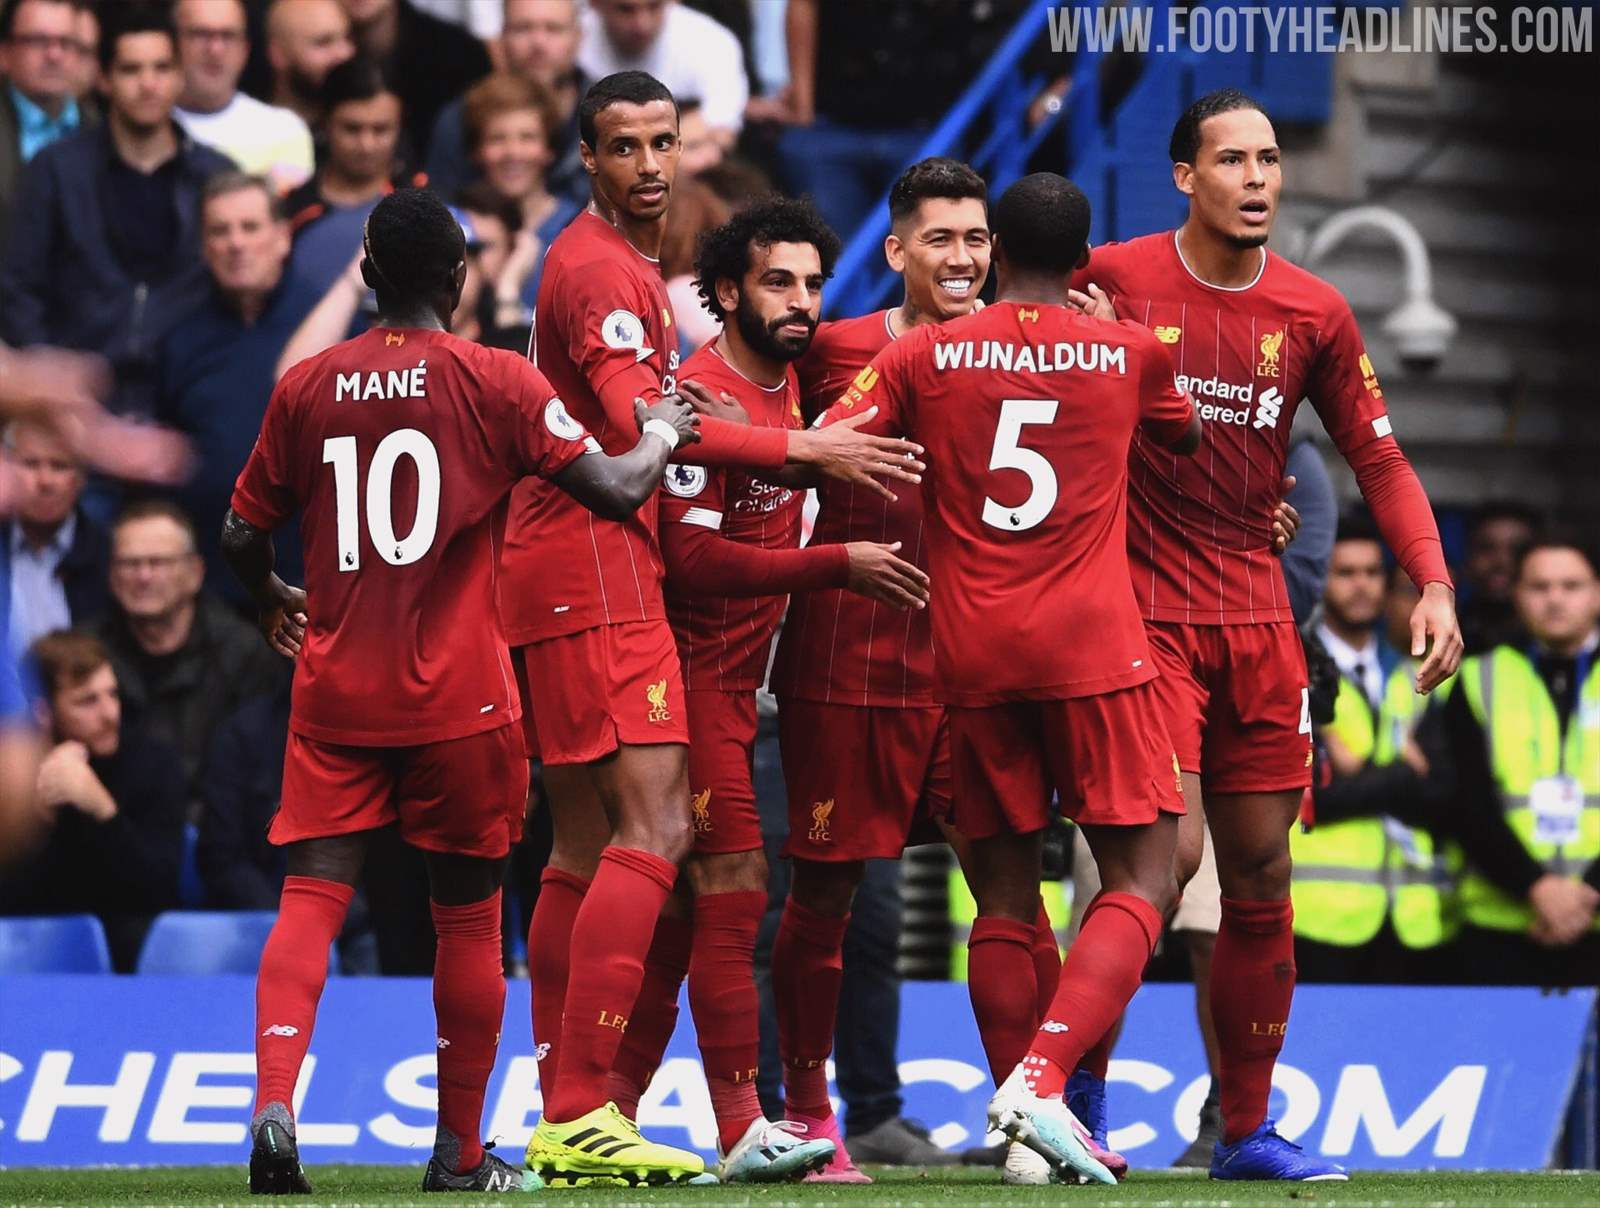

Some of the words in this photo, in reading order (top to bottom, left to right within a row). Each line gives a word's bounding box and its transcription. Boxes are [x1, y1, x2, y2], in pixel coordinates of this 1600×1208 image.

[934, 341, 1126, 374] WIJNALDUM
[335, 360, 426, 402] MANÉ
[1177, 374, 1254, 403] andard
[1195, 399, 1250, 425] tered
[982, 400, 1059, 531] 5
[322, 428, 441, 572] 10
